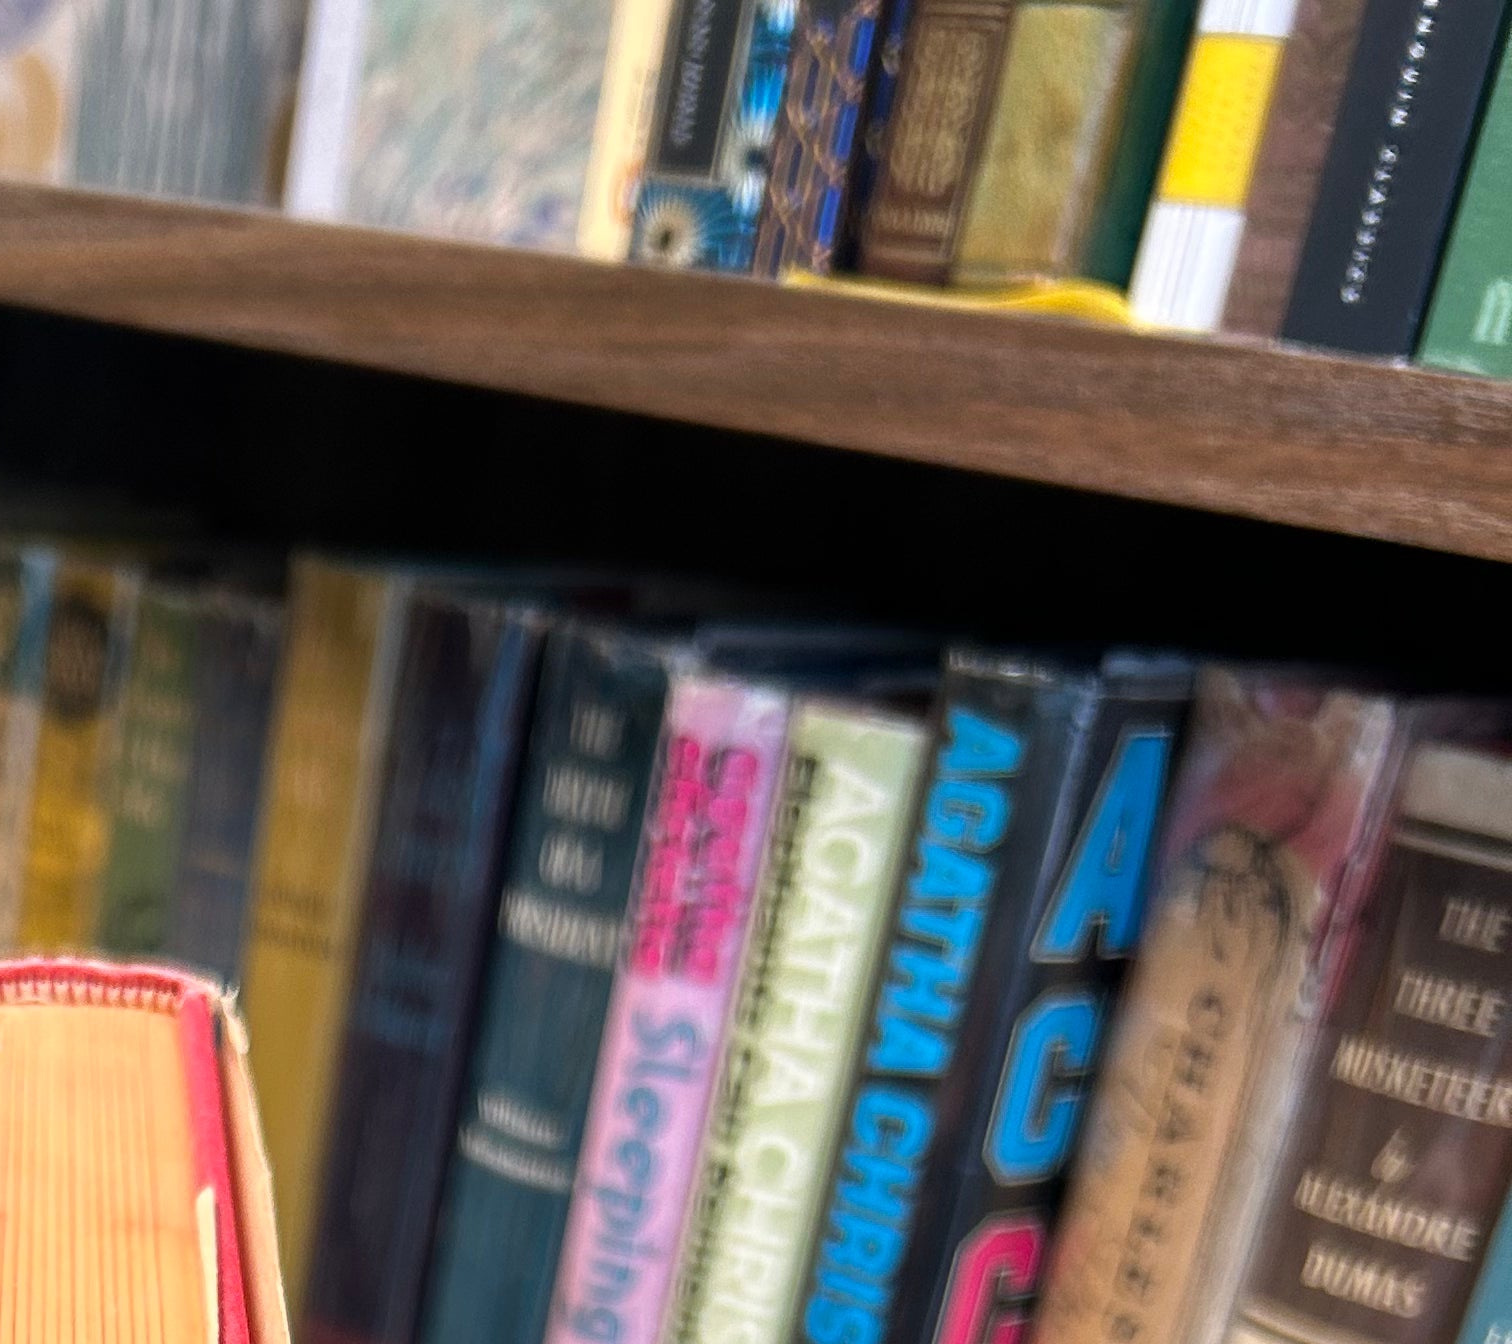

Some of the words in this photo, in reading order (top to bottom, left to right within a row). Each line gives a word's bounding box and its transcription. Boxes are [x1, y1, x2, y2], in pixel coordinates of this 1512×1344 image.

[750, 760, 890, 1106] AGATHA
[866, 703, 1028, 1078] AGATHA
[1102, 983, 1228, 1344] CHARLES
